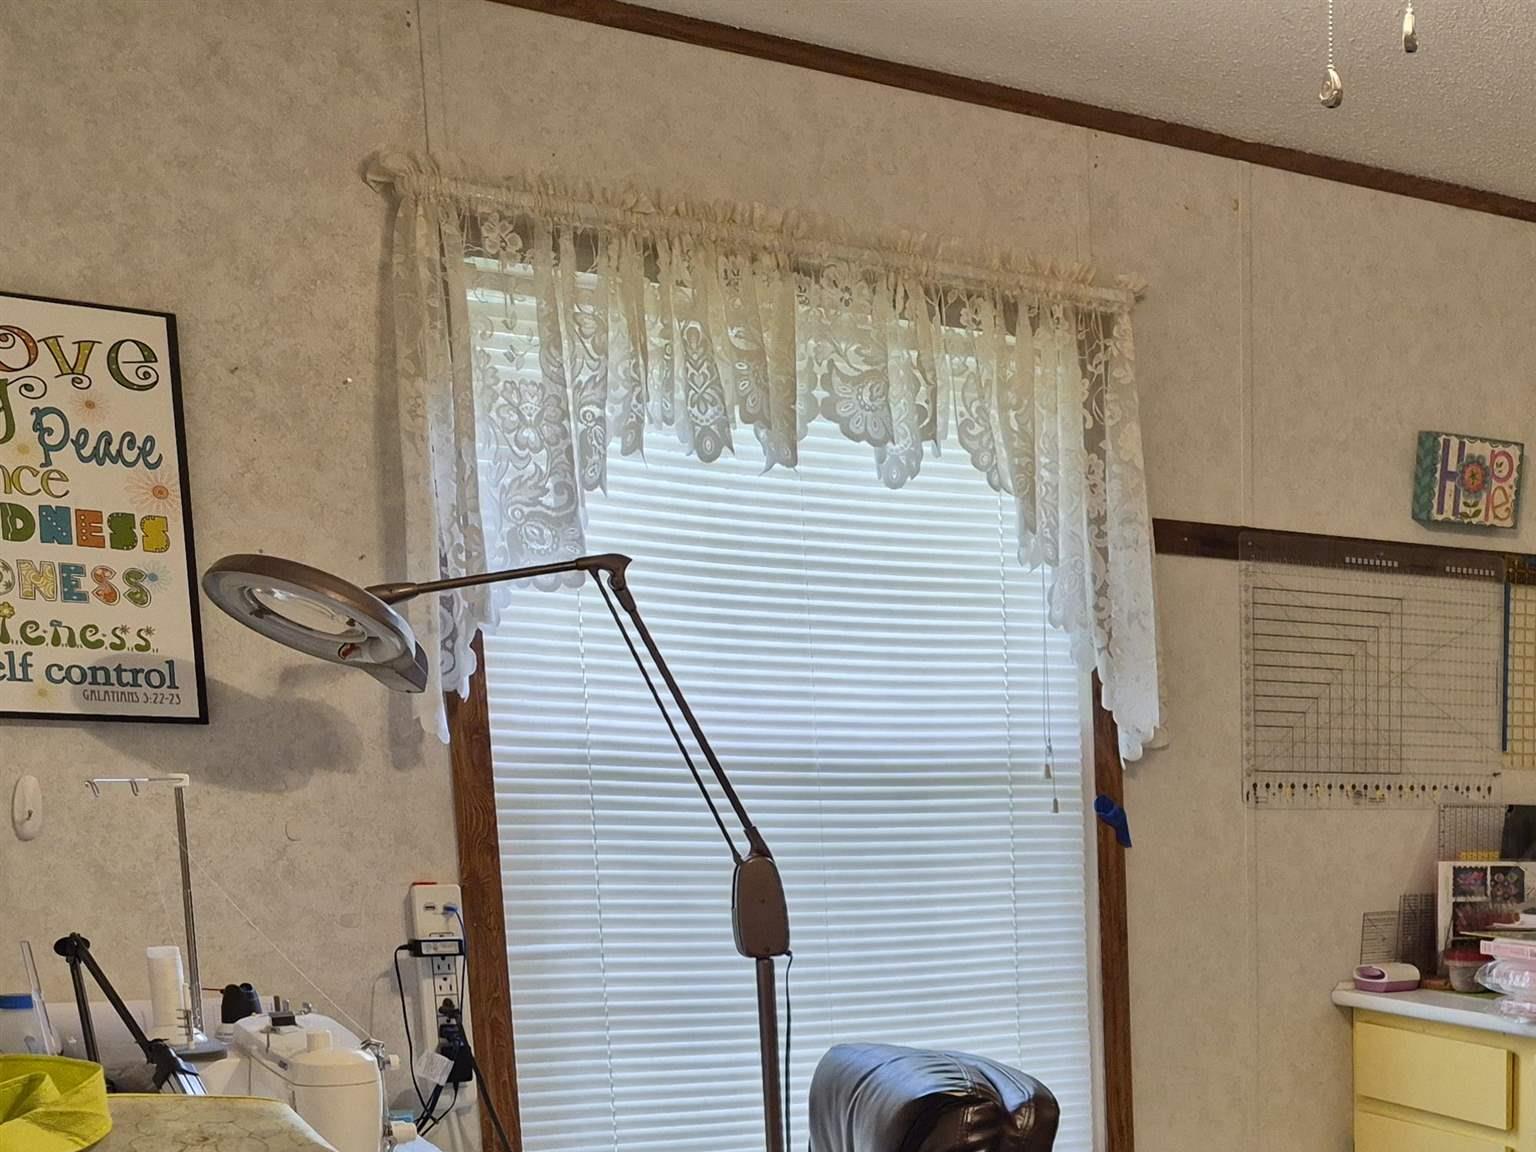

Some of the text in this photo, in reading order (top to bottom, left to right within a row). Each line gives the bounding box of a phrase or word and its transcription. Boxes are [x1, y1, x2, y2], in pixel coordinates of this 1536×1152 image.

[31, 406, 163, 470] Peace
[45, 659, 180, 690] control
[82, 689, 140, 703] GALATIANS
